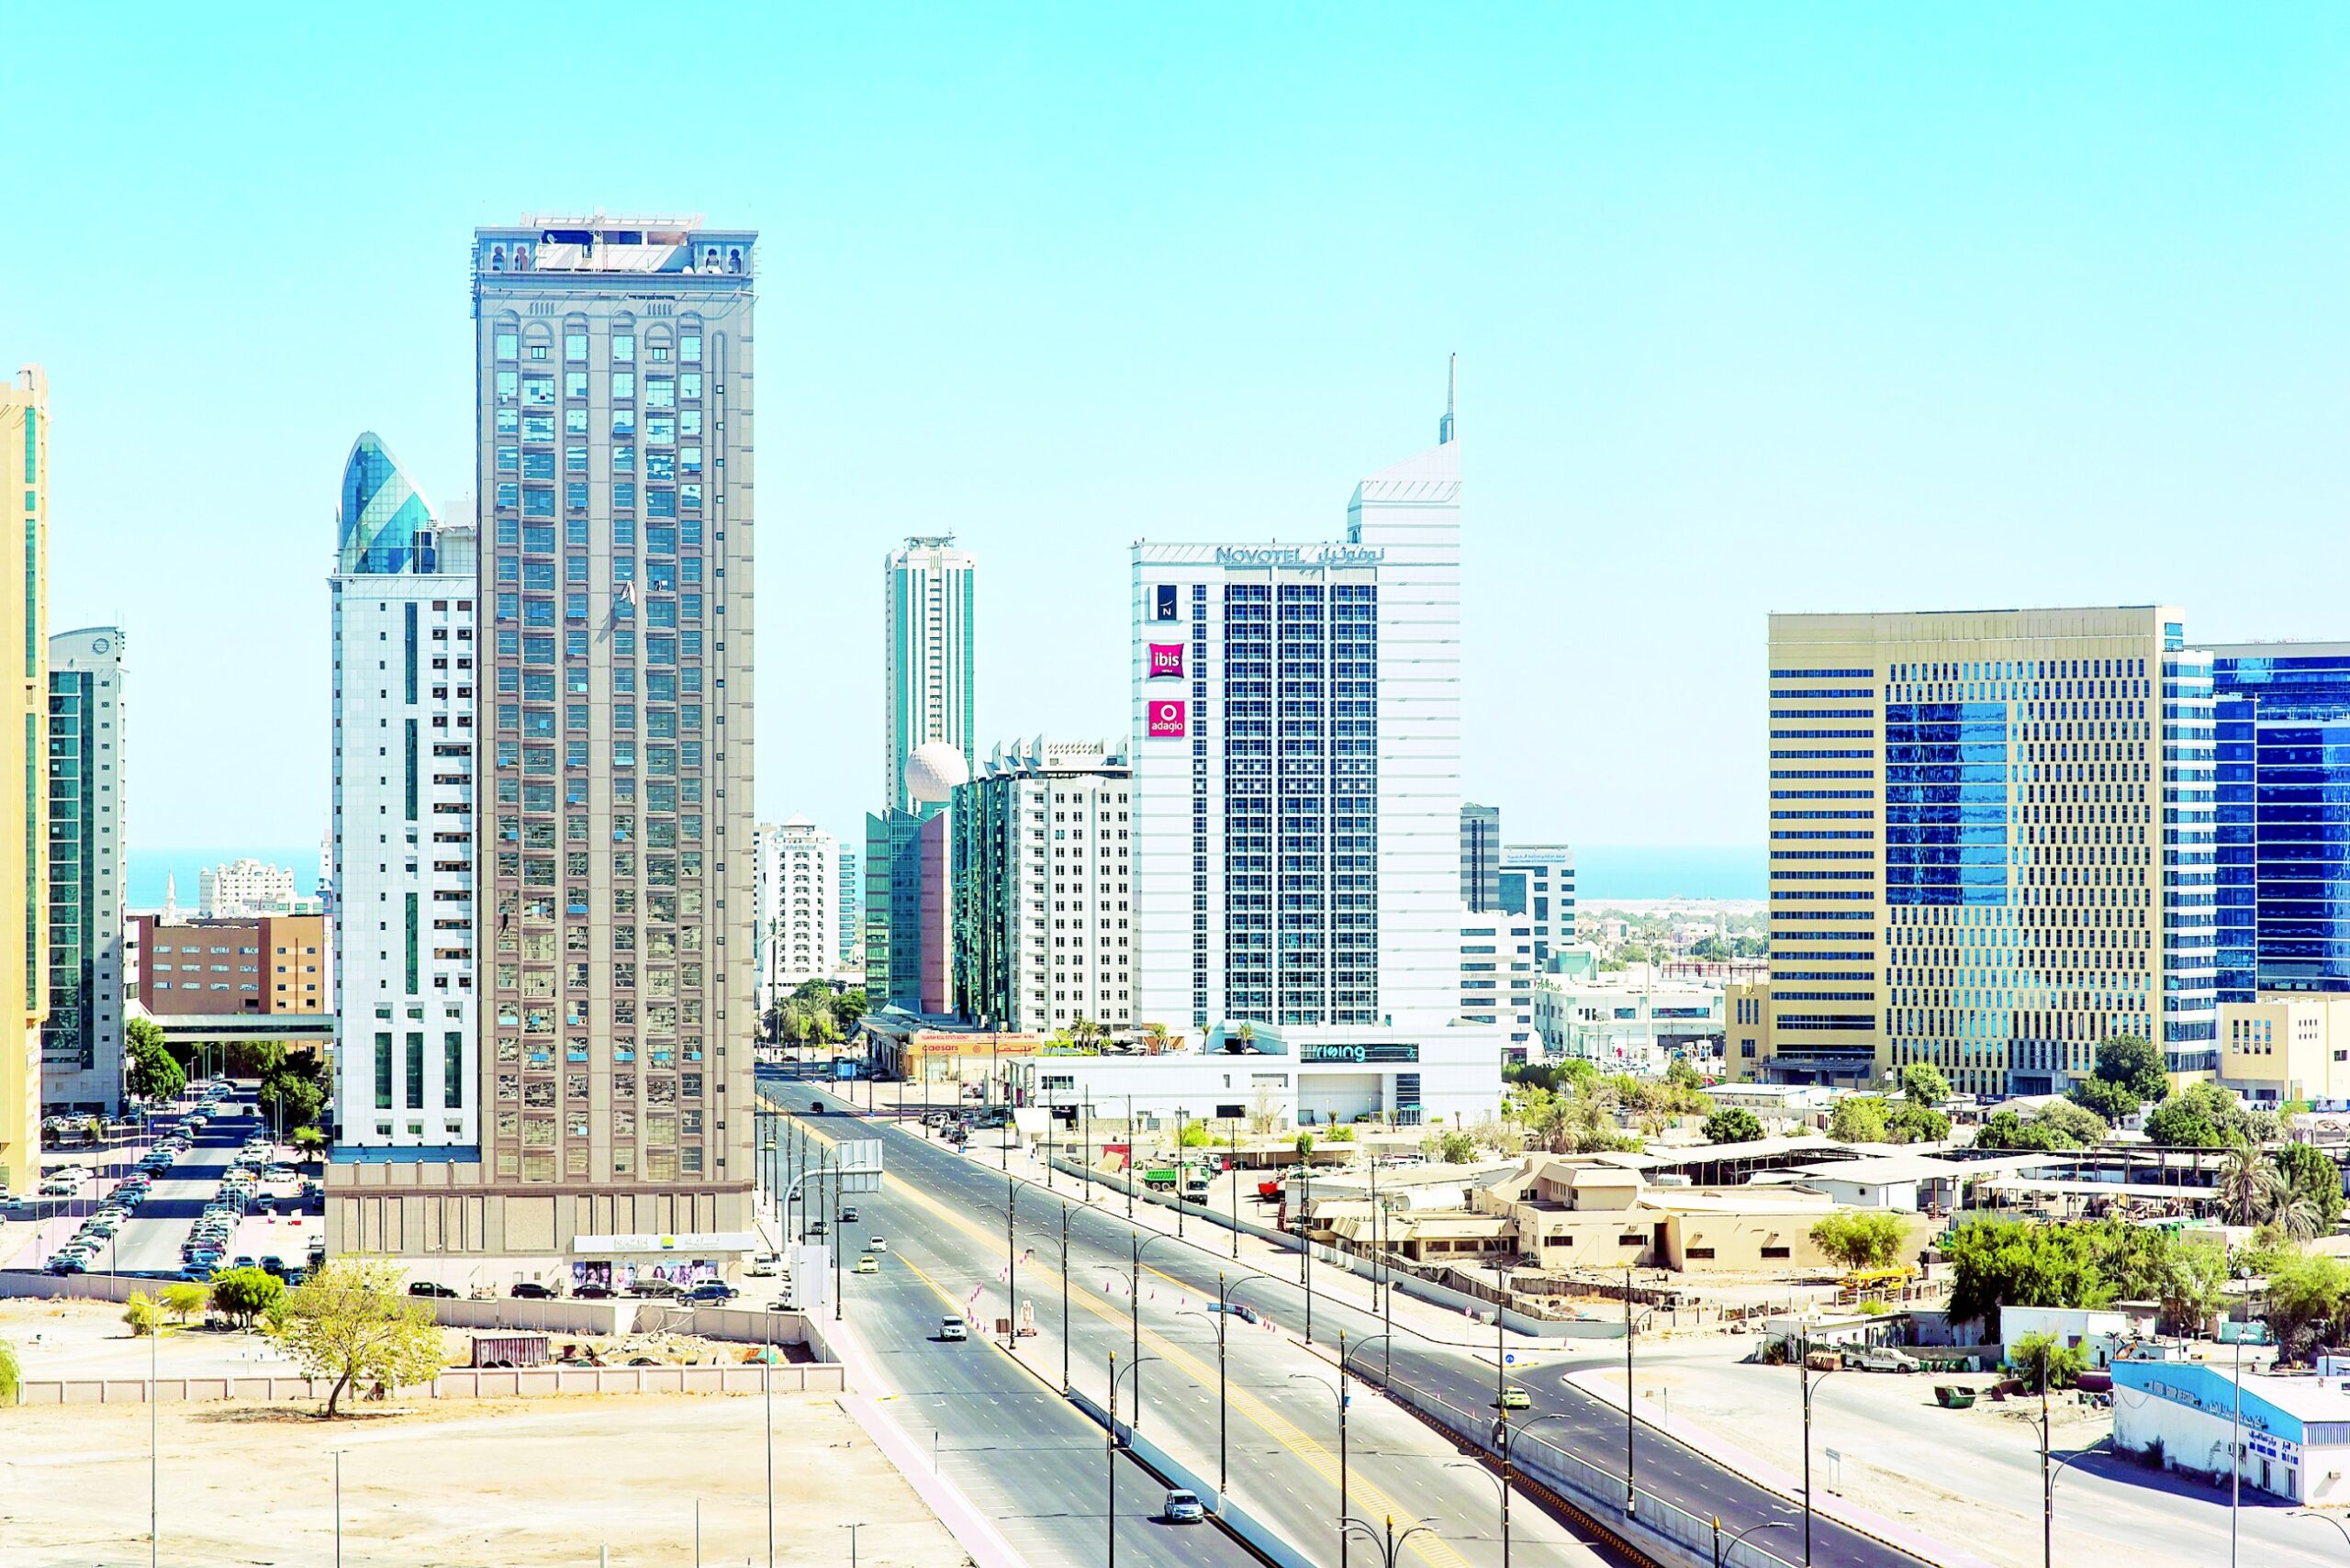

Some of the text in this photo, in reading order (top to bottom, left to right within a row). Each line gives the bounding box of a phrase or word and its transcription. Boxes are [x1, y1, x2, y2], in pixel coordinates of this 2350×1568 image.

[1216, 547, 1303, 564] NOVOTEL
[1162, 607, 1171, 616] N
[1155, 652, 1180, 666] ibis
[1151, 721, 1183, 733] adagio
[922, 1044, 959, 1052] caesars
[1315, 1045, 1366, 1063] rising
